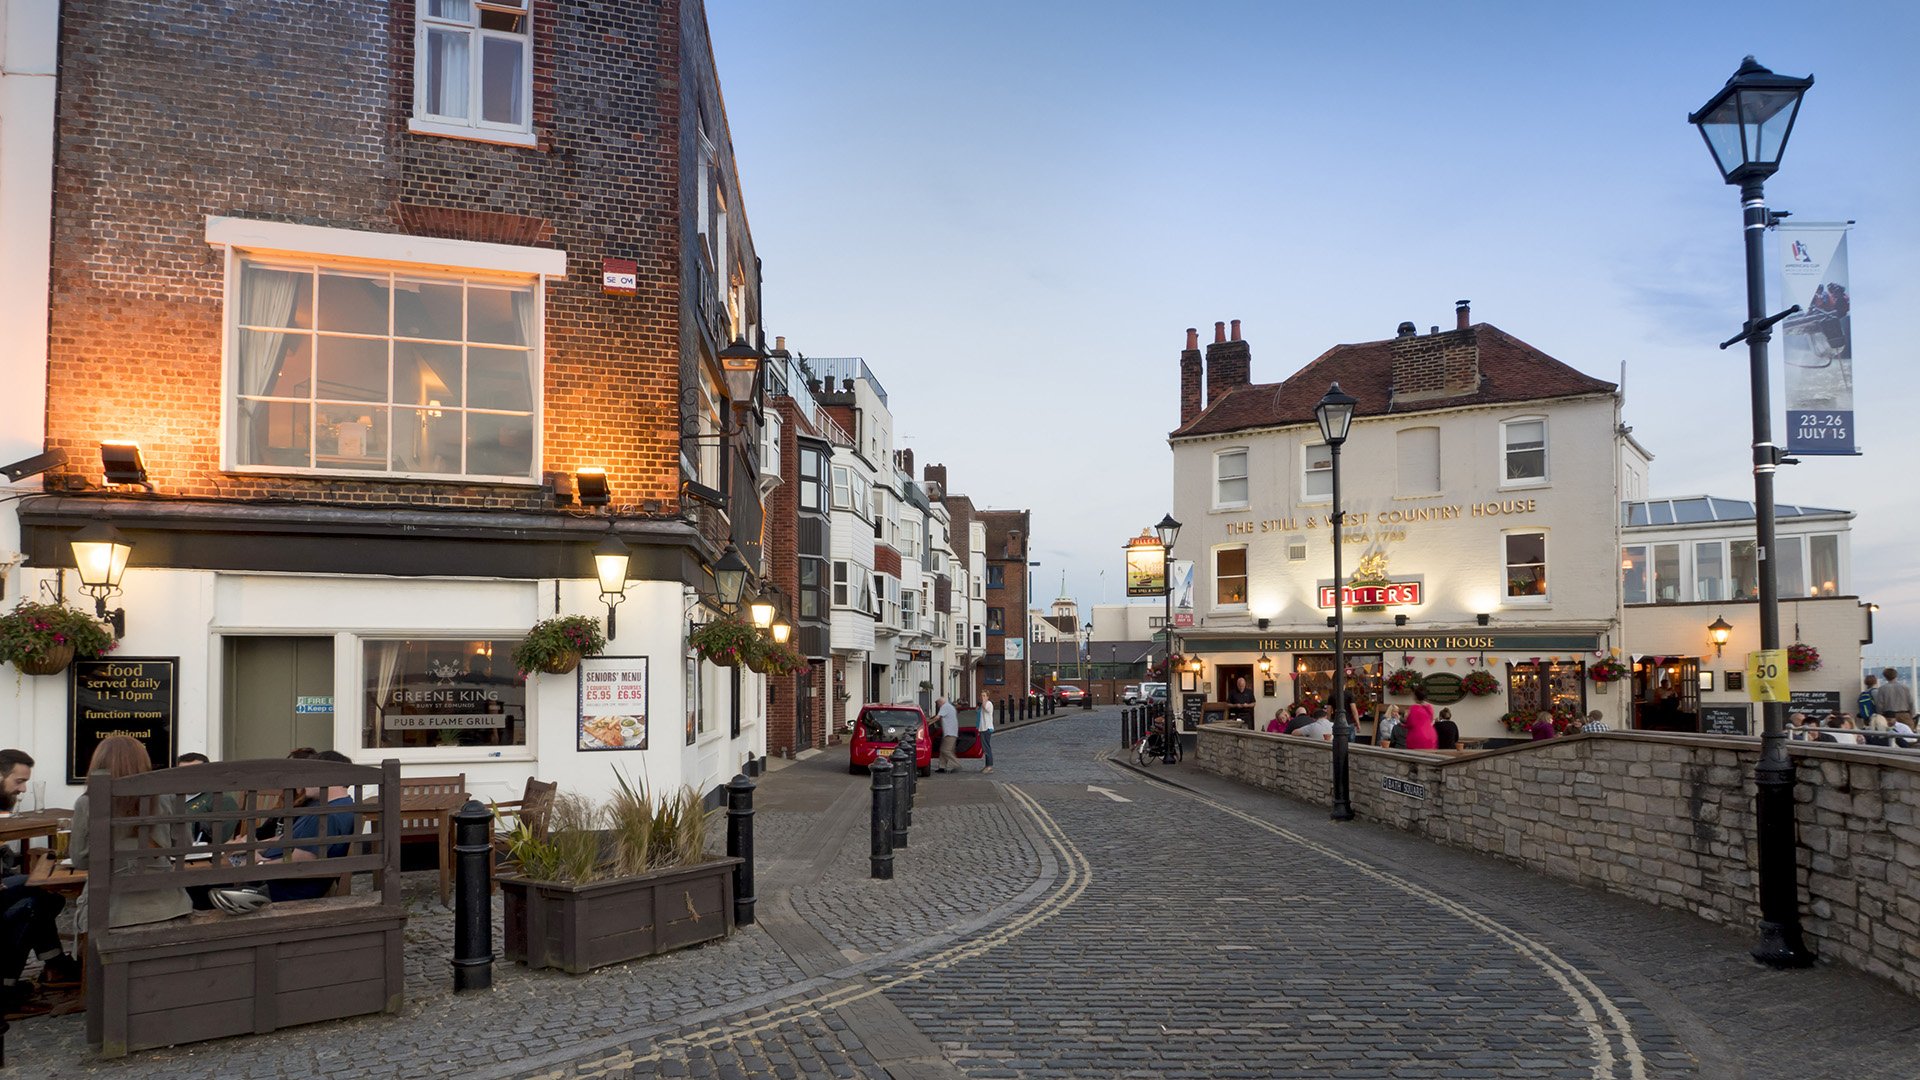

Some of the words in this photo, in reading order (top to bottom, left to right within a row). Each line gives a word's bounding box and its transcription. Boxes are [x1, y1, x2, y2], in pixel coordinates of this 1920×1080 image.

[1800, 414, 1842, 426] 23-26
[1796, 428, 1826, 439] JULY
[1832, 428, 1846, 439] 15
[1226, 522, 1253, 535] THE
[1261, 518, 1298, 532] STILL
[1306, 516, 1318, 529] &
[1378, 504, 1464, 524] COUNTRY
[1472, 500, 1536, 517] HOUSE
[1258, 640, 1280, 650] THE
[1285, 639, 1314, 649] STILL
[1320, 639, 1328, 649] &
[1374, 638, 1440, 648] COUNTRY
[1446, 637, 1494, 648] HOUSE
[107, 664, 142, 676] food
[1756, 664, 1777, 678] 50
[586, 672, 619, 682] SENIORS'
[622, 672, 641, 681] MENU
[88, 678, 126, 688] served
[132, 678, 160, 690] daily
[97, 691, 153, 702] 11-10pm
[393, 690, 453, 702] GREENE
[460, 690, 498, 701] KING
[586, 691, 611, 700] £5.95
[617, 691, 641, 699] £6.95
[86, 710, 130, 719] function
[1404, 784, 1423, 798] SQUARE
